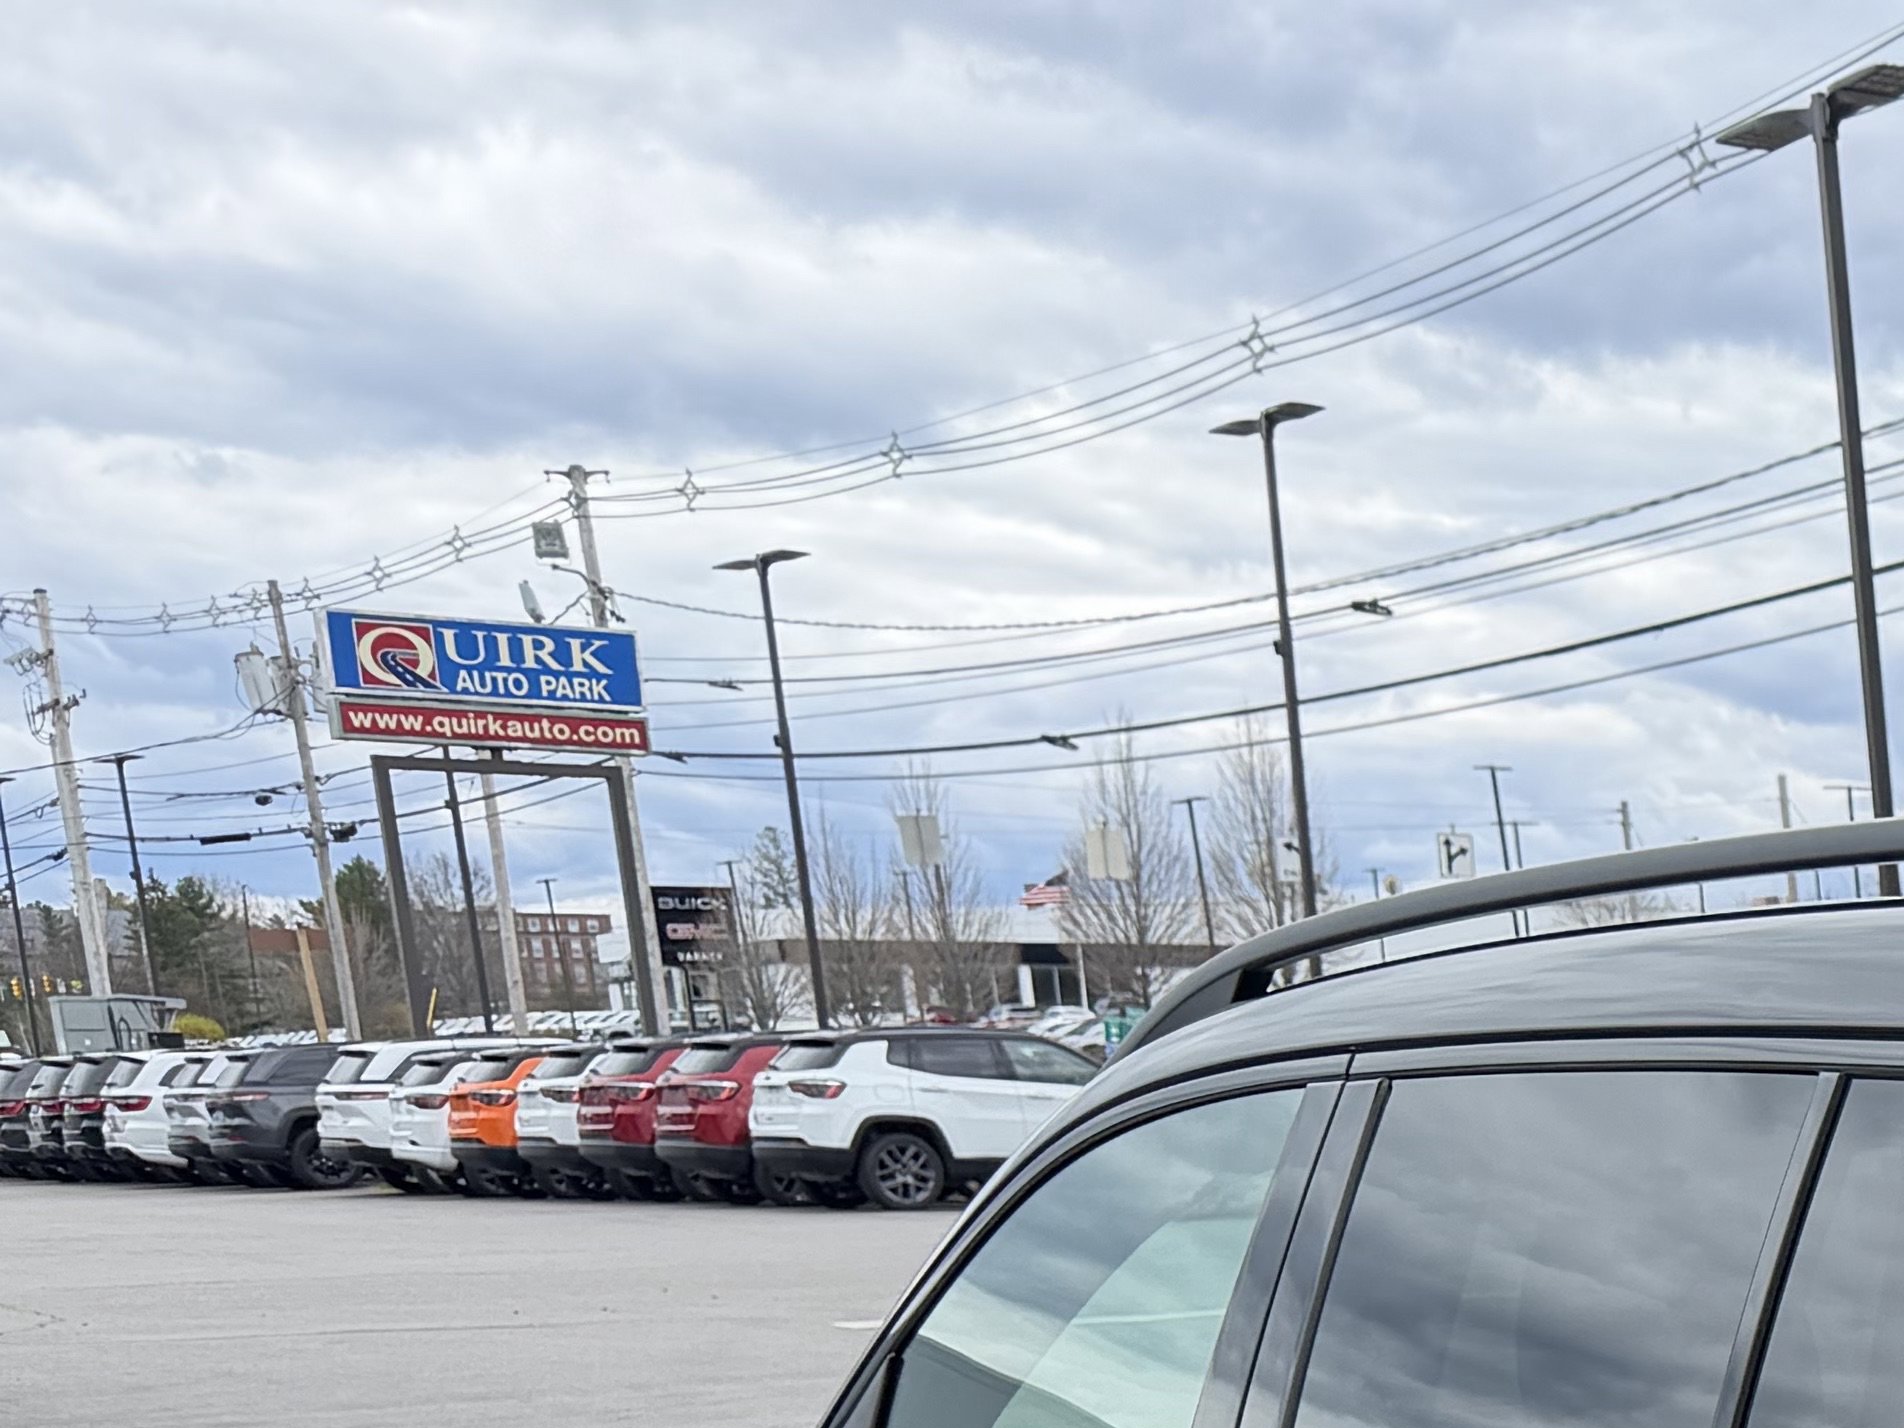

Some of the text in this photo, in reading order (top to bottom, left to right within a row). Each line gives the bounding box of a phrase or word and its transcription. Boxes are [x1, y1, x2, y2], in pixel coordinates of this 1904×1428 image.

[358, 626, 614, 687] QUIRK
[456, 669, 612, 702] AUTO PARK
[348, 710, 641, 745] www.quirkauto.com
